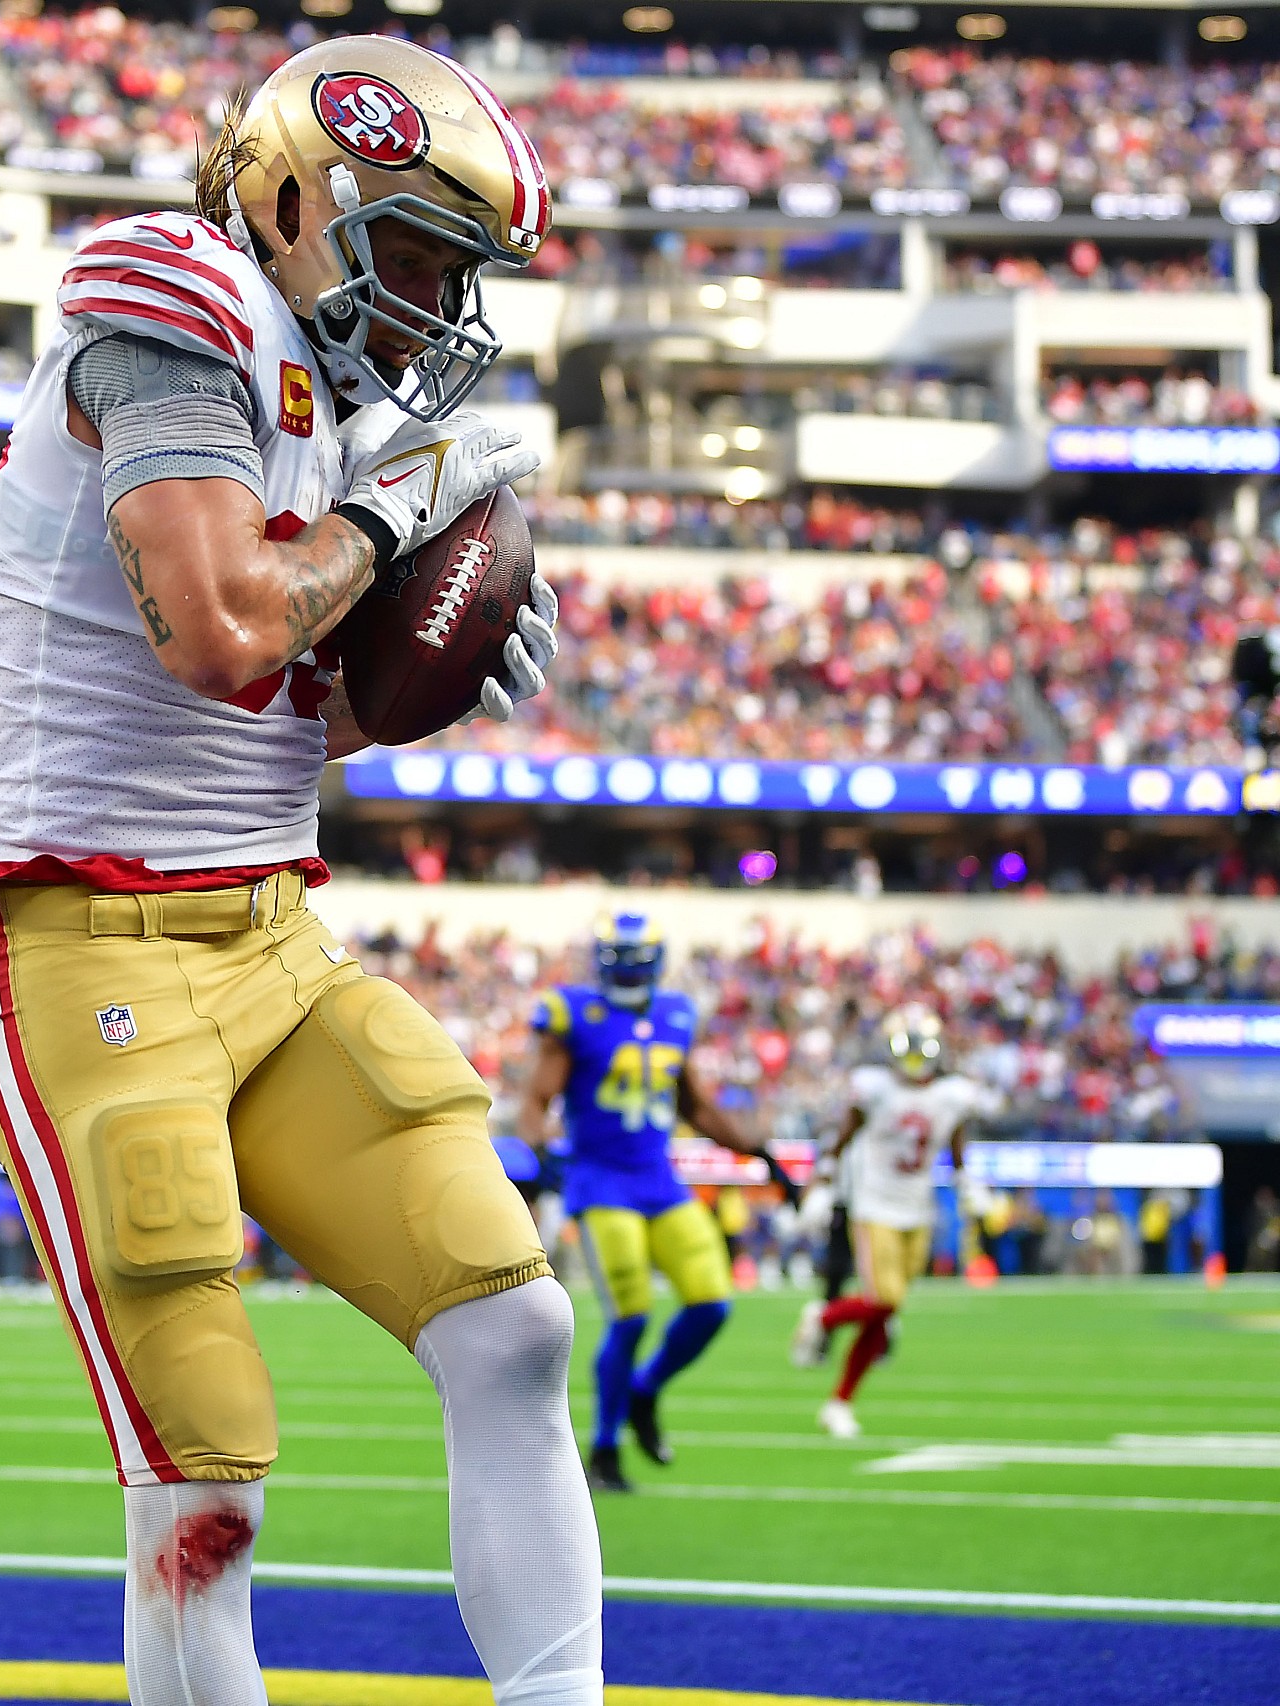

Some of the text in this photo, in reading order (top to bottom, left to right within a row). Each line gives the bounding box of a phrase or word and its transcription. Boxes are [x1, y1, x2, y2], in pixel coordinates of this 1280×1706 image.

[283, 366, 312, 417] C
[105, 1021, 131, 1039] NFL
[595, 1043, 683, 1132] 45
[121, 1134, 231, 1230] 85
